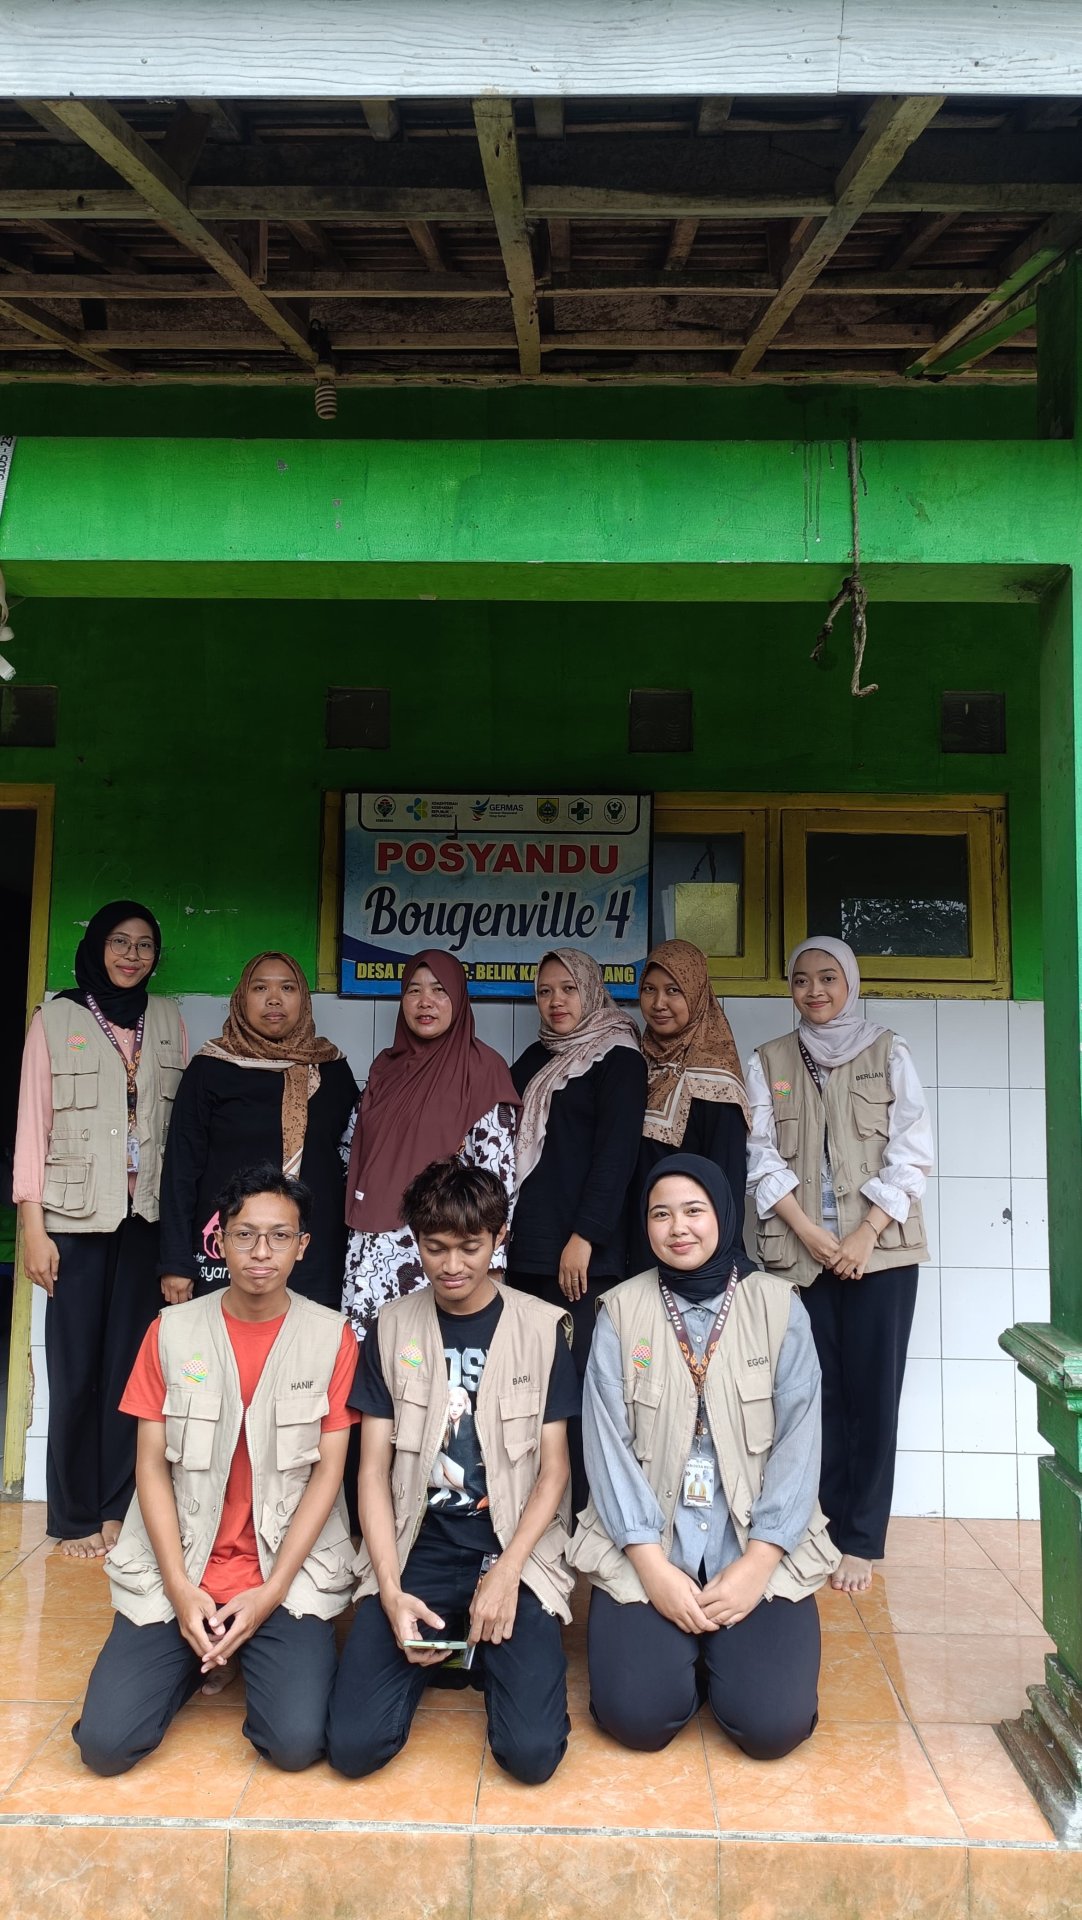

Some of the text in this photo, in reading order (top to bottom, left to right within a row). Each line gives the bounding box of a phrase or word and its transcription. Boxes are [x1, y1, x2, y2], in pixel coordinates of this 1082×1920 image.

[489, 803, 524, 812] GERMAS
[377, 842, 619, 874] POSYANDU
[365, 886, 631, 951] Bougenville 4
[357, 962, 394, 979] DESA
[475, 964, 516, 980] BELIK
[855, 1071, 884, 1081] BERLIAN
[747, 1356, 769, 1368] EGGA
[290, 1380, 314, 1391] HANIF
